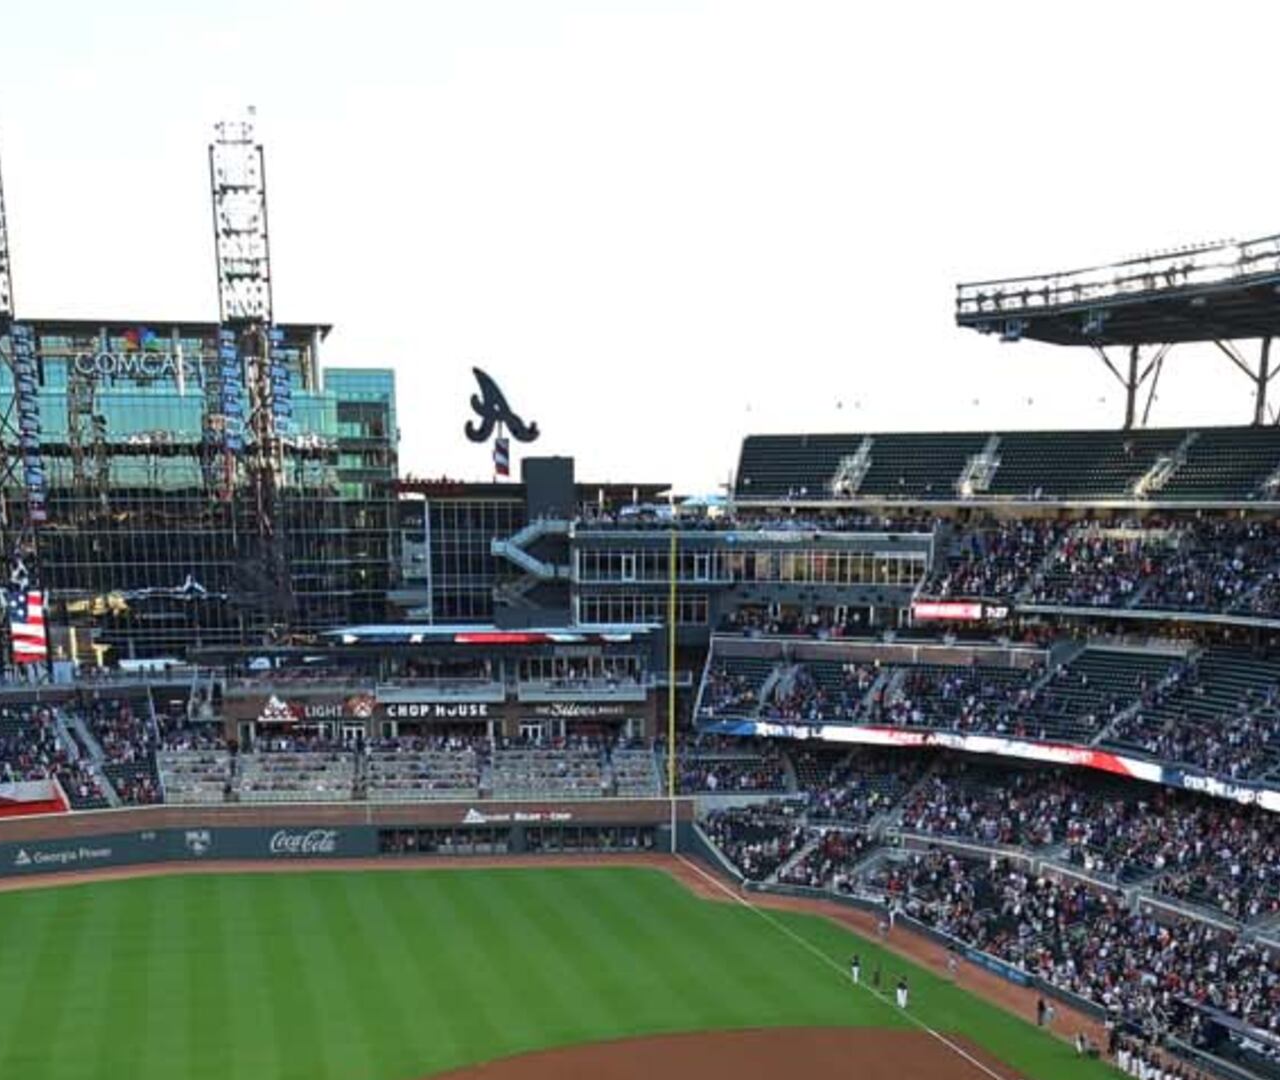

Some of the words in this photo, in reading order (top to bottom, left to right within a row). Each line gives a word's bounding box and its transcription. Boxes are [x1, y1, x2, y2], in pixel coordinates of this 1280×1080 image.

[74, 351, 207, 375] COMCAST
[304, 705, 343, 717] LIGHT
[386, 704, 429, 717] CHOP
[33, 850, 78, 864] Georgia
